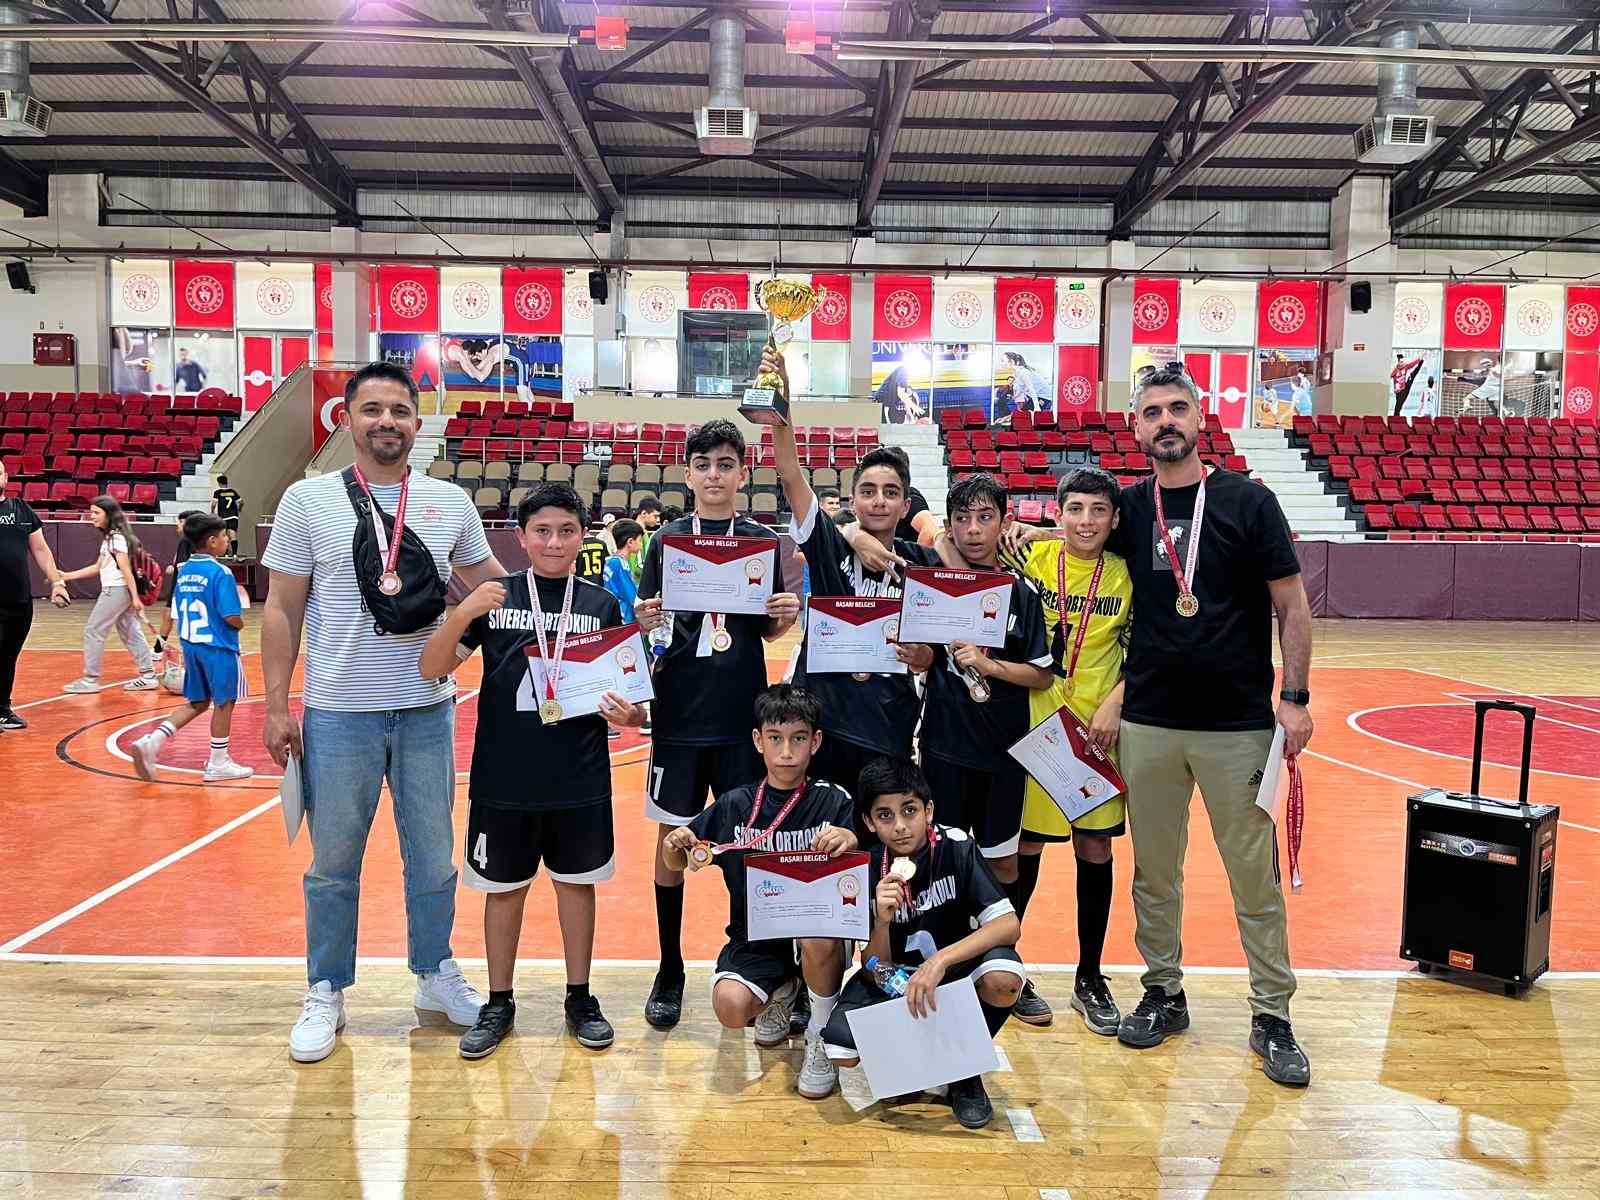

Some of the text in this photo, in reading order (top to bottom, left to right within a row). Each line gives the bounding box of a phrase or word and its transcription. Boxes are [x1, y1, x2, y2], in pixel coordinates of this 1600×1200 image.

[225, 496, 233, 508] 7
[582, 551, 602, 576] 15
[179, 598, 214, 643] 12
[473, 832, 488, 870] 4
